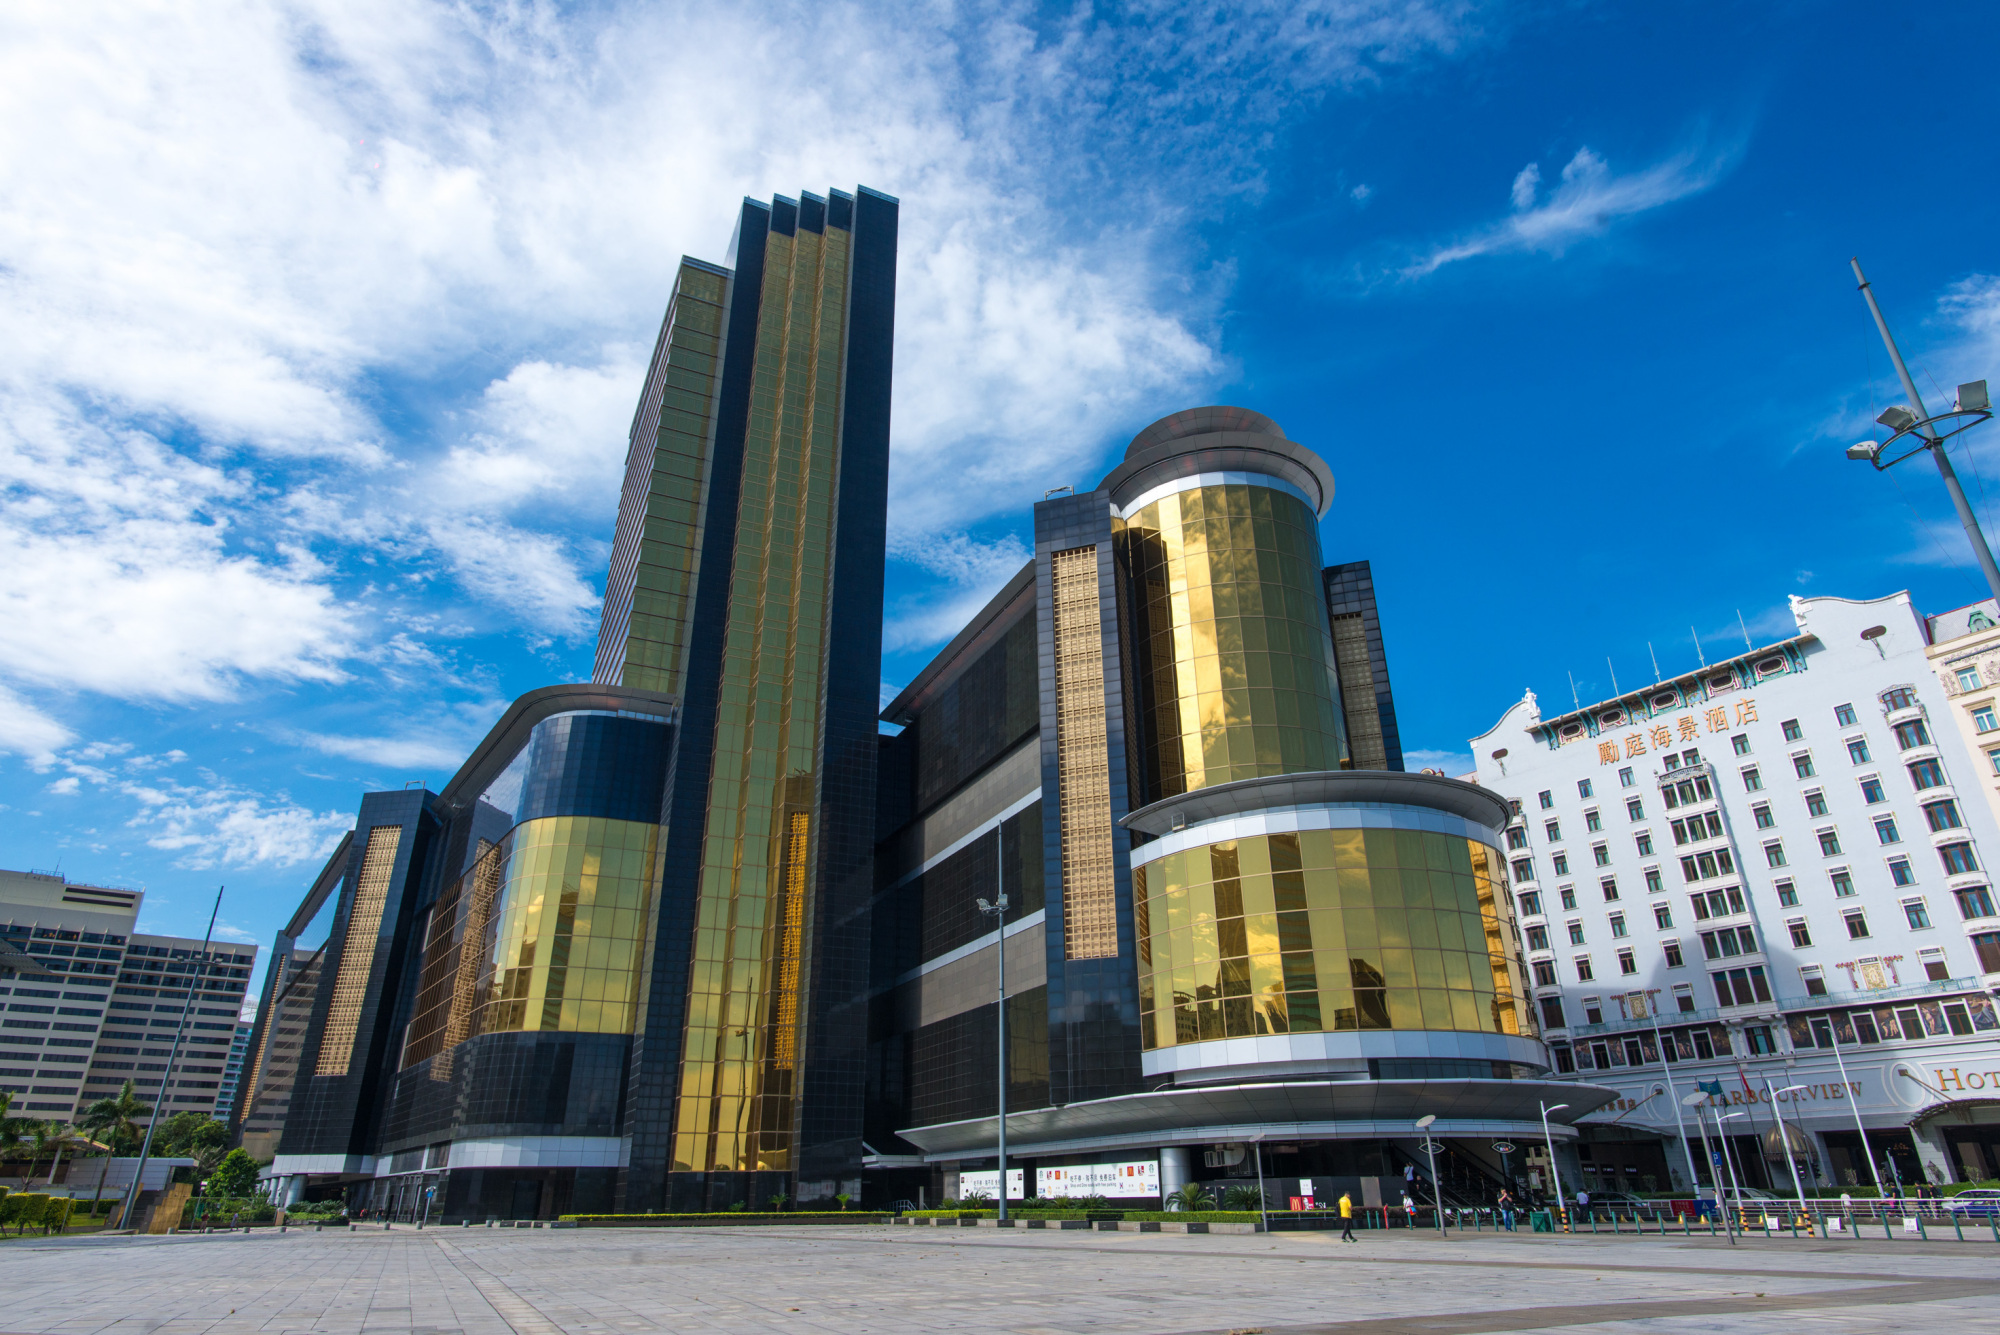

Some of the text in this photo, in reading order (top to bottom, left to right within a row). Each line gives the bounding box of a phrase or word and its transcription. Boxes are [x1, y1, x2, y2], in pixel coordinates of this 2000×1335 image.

[1596, 697, 1759, 766] 勵庭海景酒店
